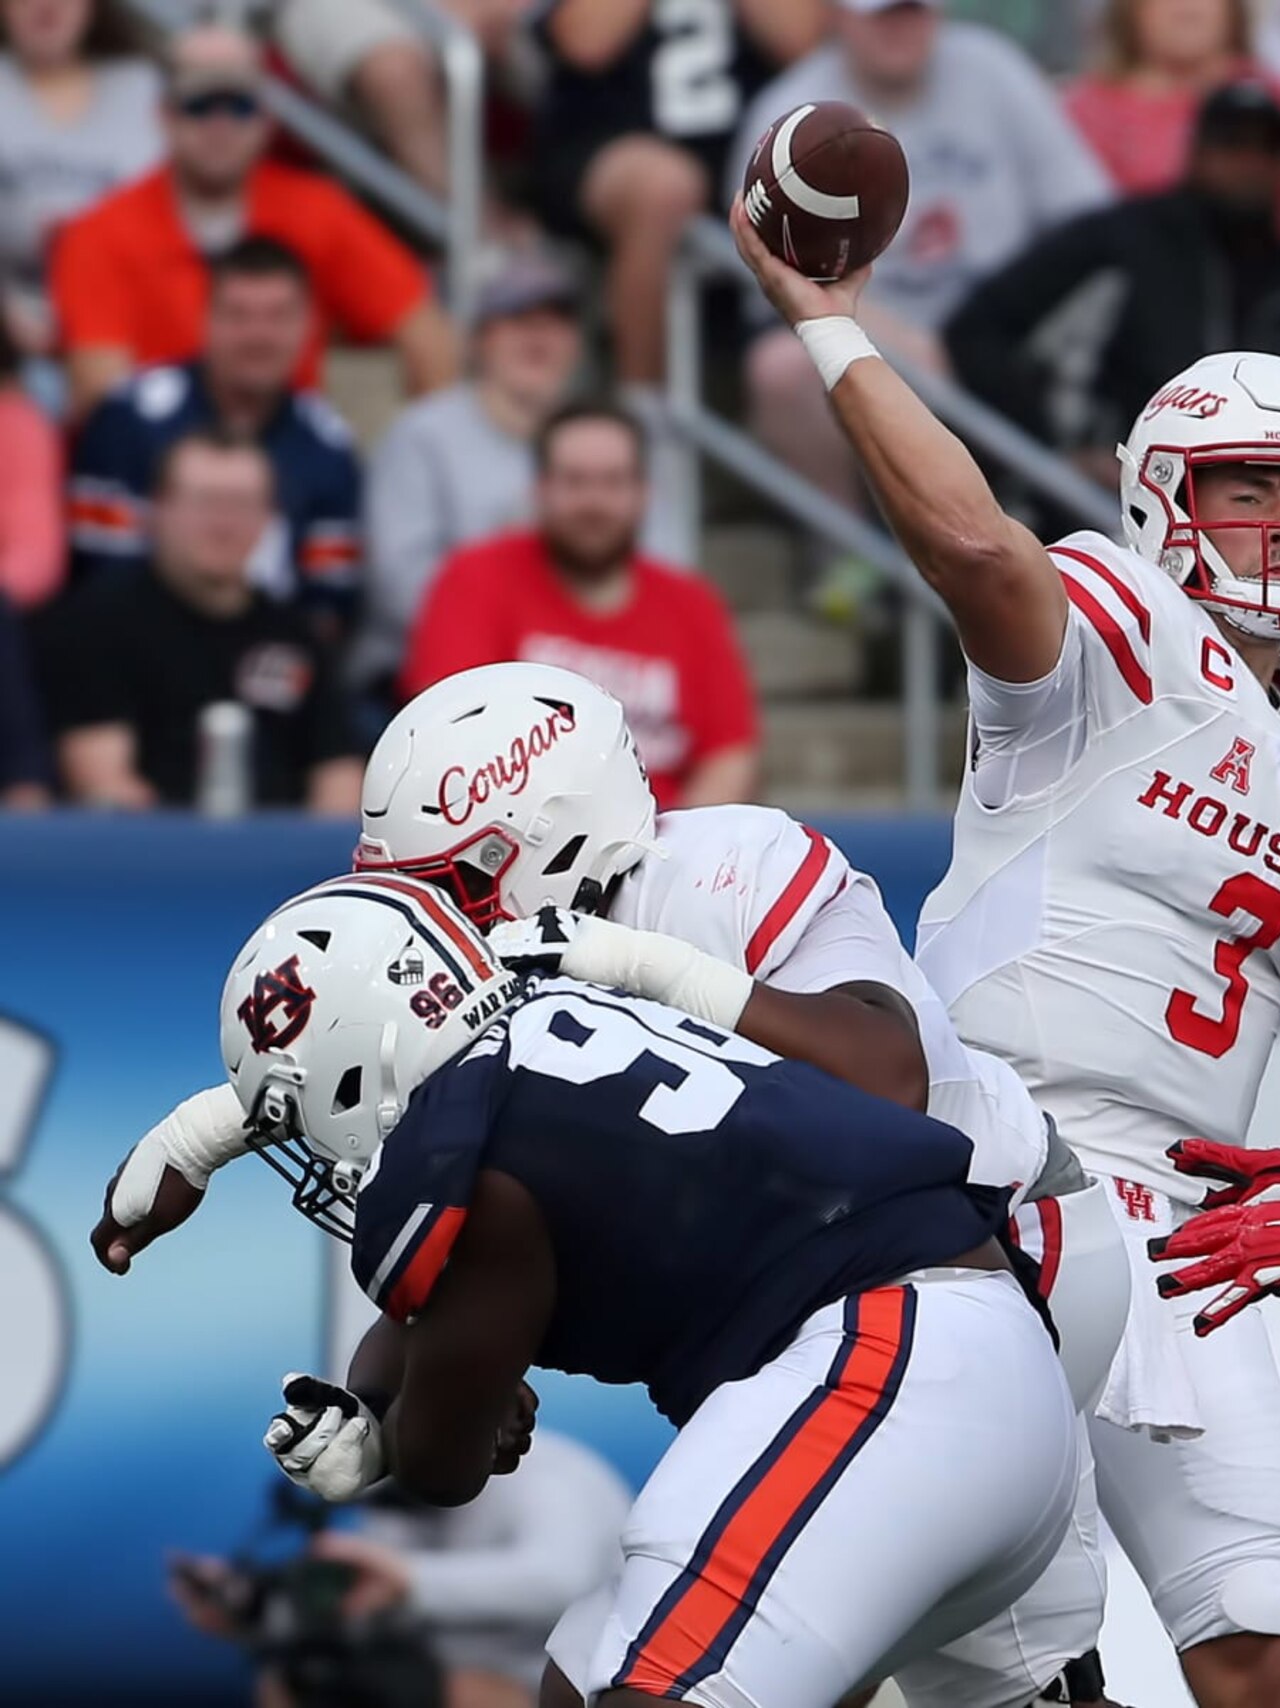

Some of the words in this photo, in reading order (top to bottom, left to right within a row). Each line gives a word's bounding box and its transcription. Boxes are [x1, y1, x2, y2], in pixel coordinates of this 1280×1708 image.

[650, 0, 738, 134] 2
[1201, 636, 1234, 692] C
[438, 705, 576, 825] Cougars
[409, 972, 464, 1030] 96
[462, 992, 501, 1030] WAR
